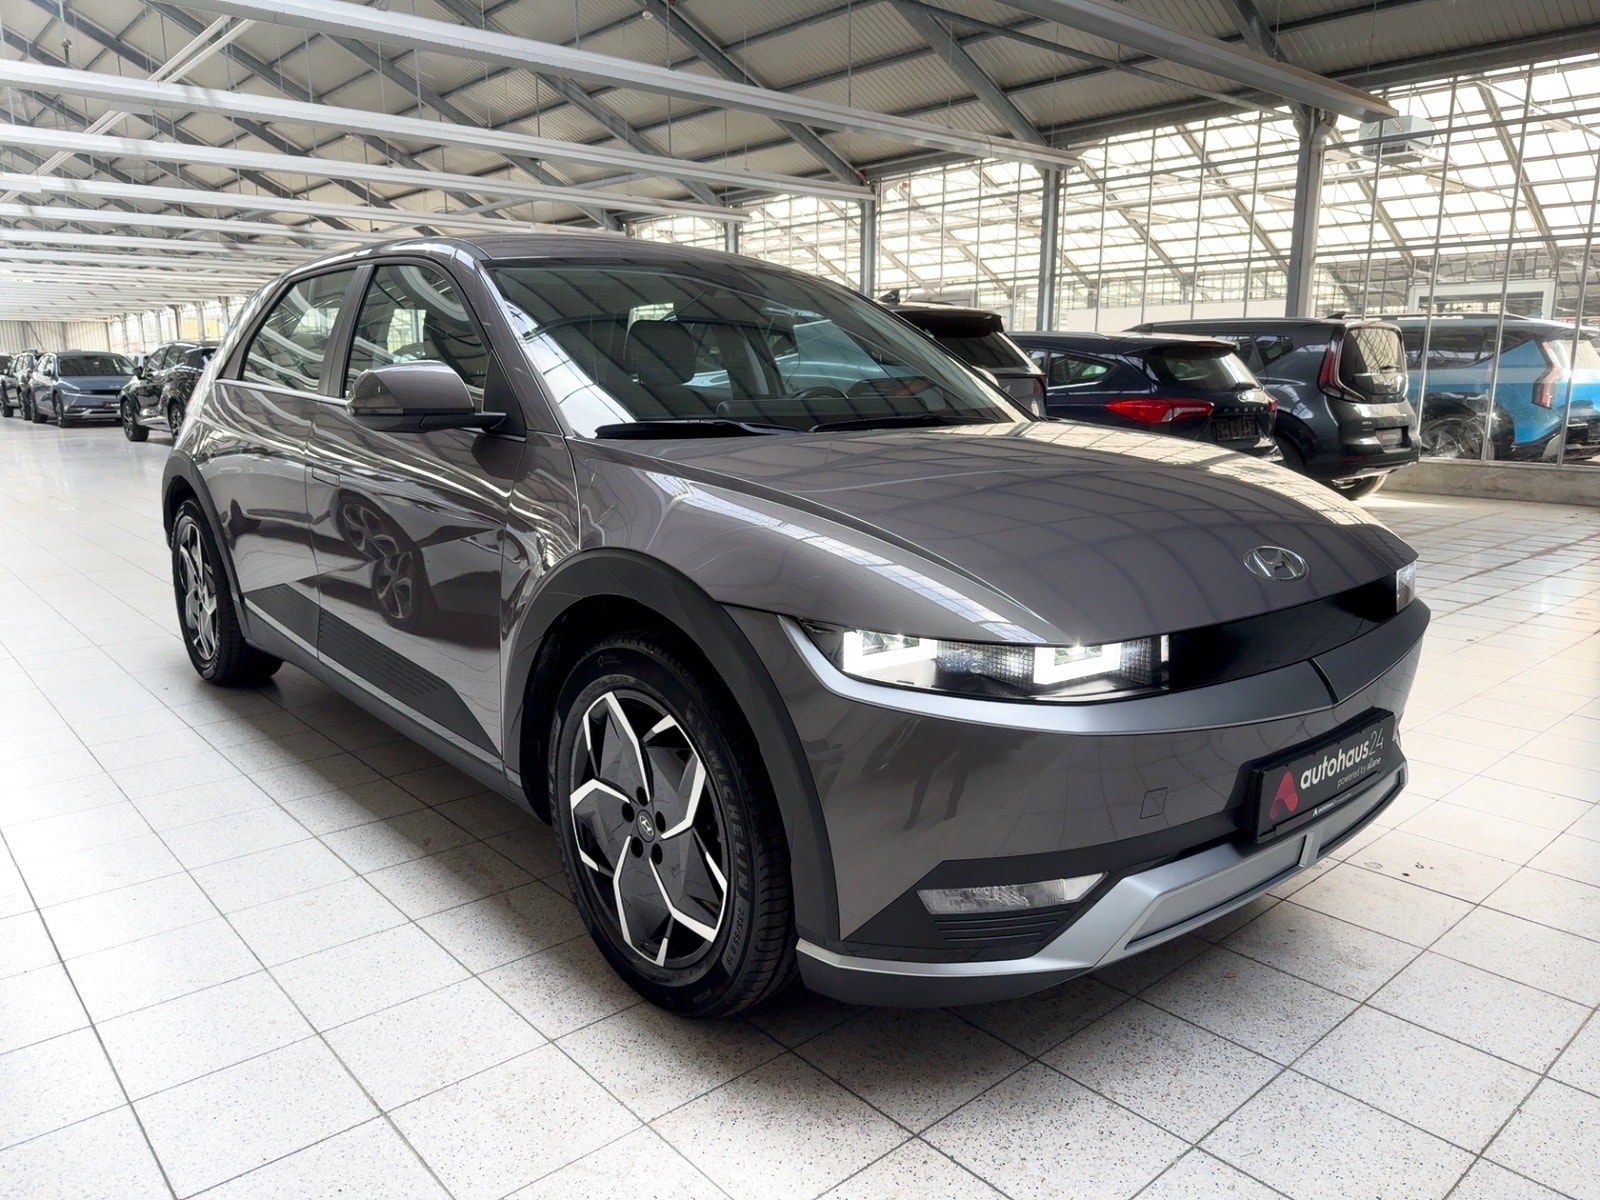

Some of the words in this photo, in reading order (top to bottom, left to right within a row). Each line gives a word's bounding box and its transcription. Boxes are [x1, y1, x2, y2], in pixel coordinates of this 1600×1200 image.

[1300, 727, 1385, 790] autohaus24
[1337, 768, 1360, 789] powered
[708, 750, 749, 892] MICHELIN
